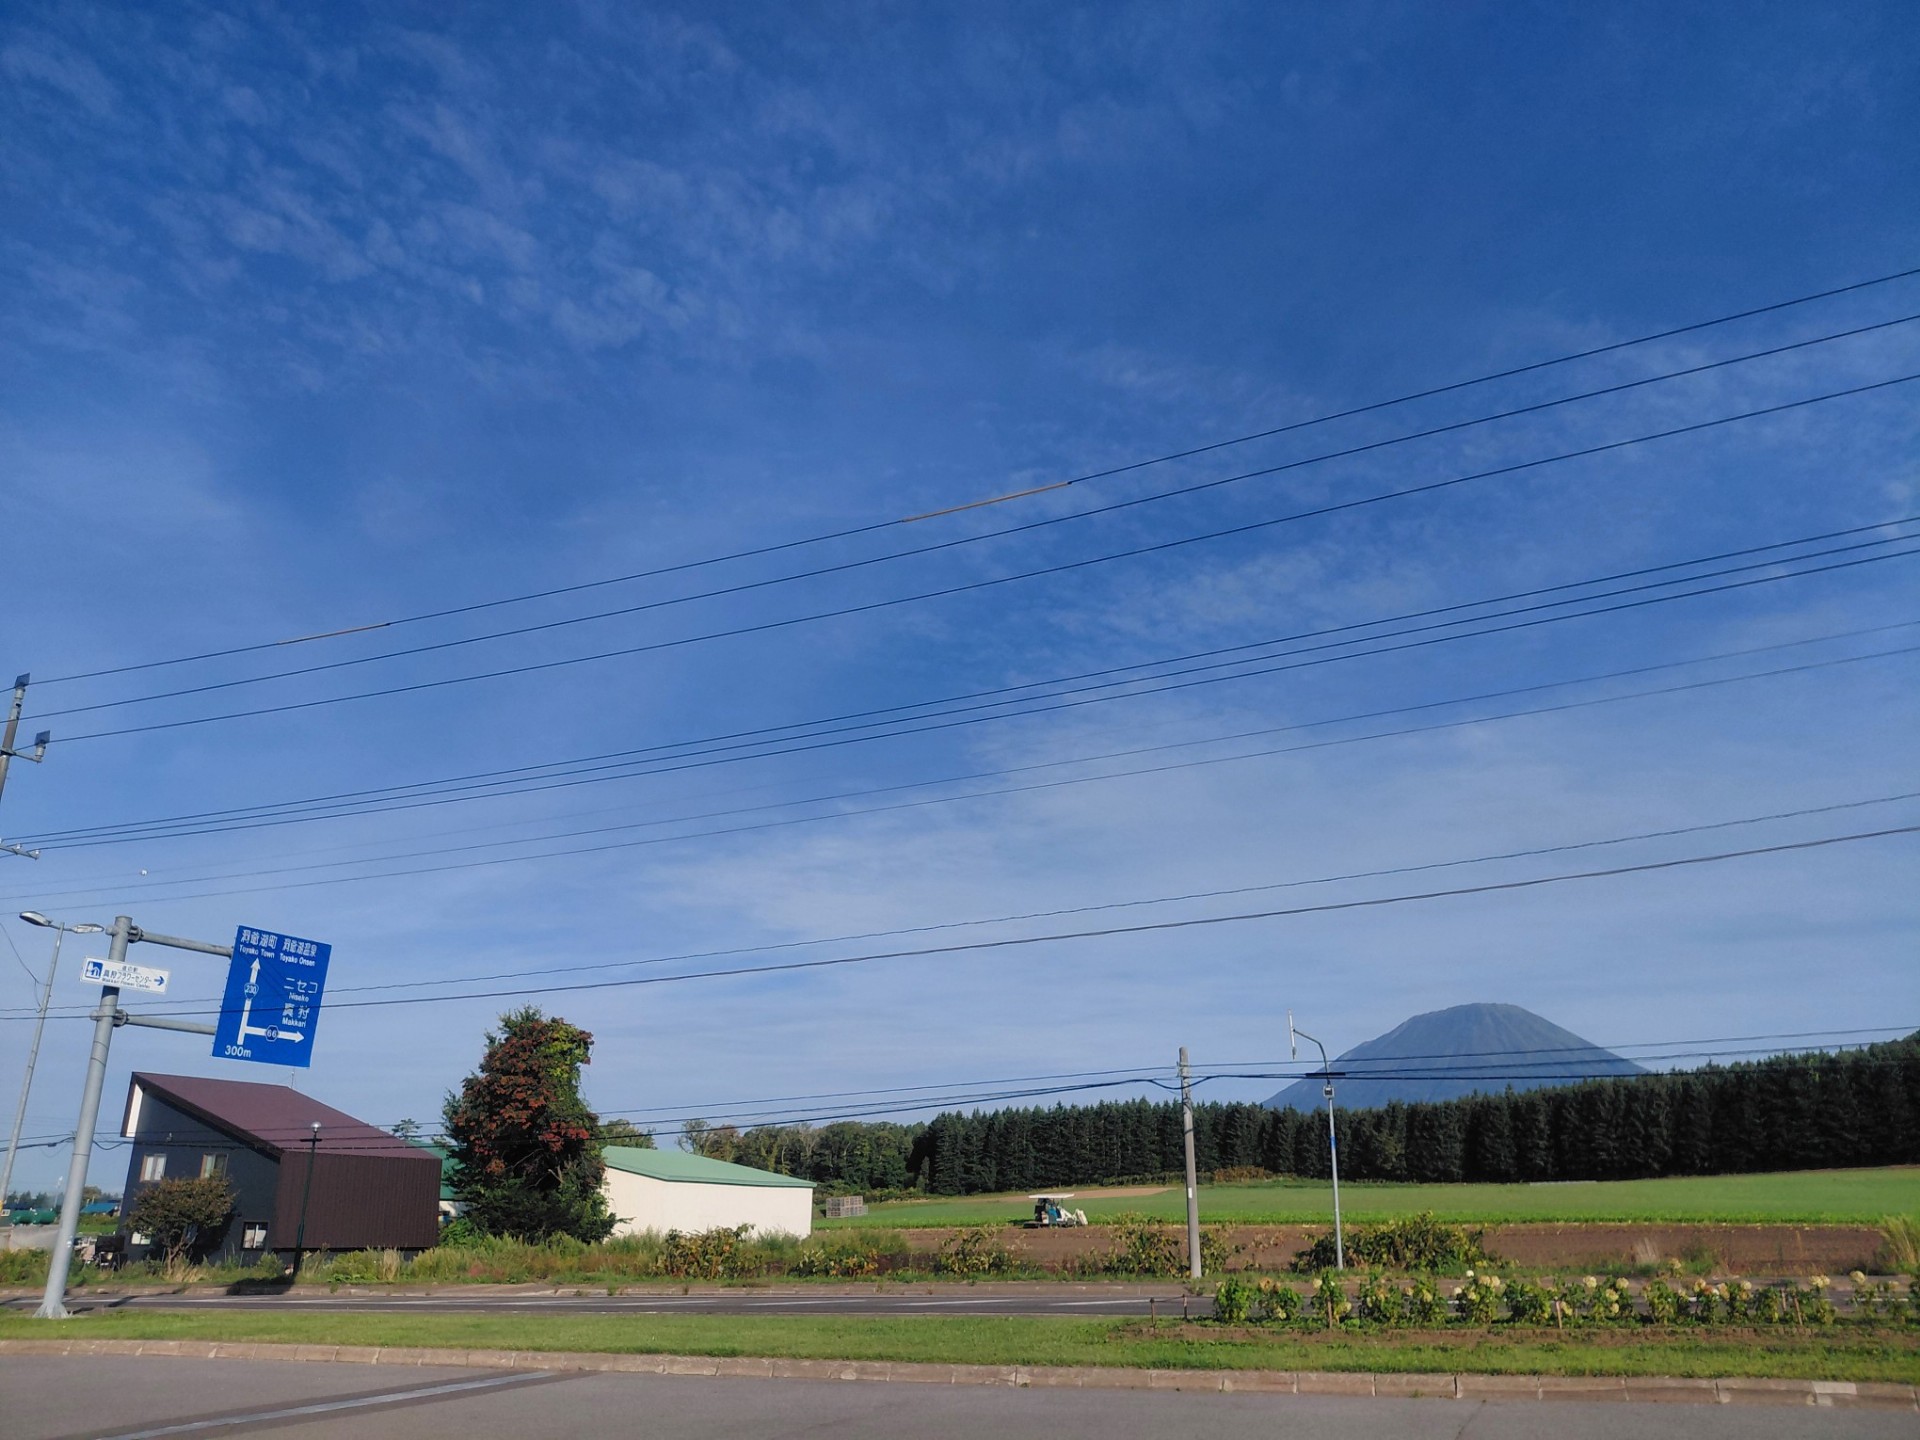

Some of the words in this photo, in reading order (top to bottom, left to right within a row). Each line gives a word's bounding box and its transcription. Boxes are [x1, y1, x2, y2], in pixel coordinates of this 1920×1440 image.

[239, 945, 259, 955] Toyako
[260, 948, 275, 958] Town
[280, 953, 298, 964] Toyako
[299, 957, 315, 967] Onsen
[245, 985, 257, 994] 230
[284, 977, 318, 993] ニセコ
[288, 992, 309, 1002] Niseko
[282, 1017, 307, 1028] Makkari
[266, 1030, 277, 1038] 66
[225, 1045, 252, 1057] 300m
